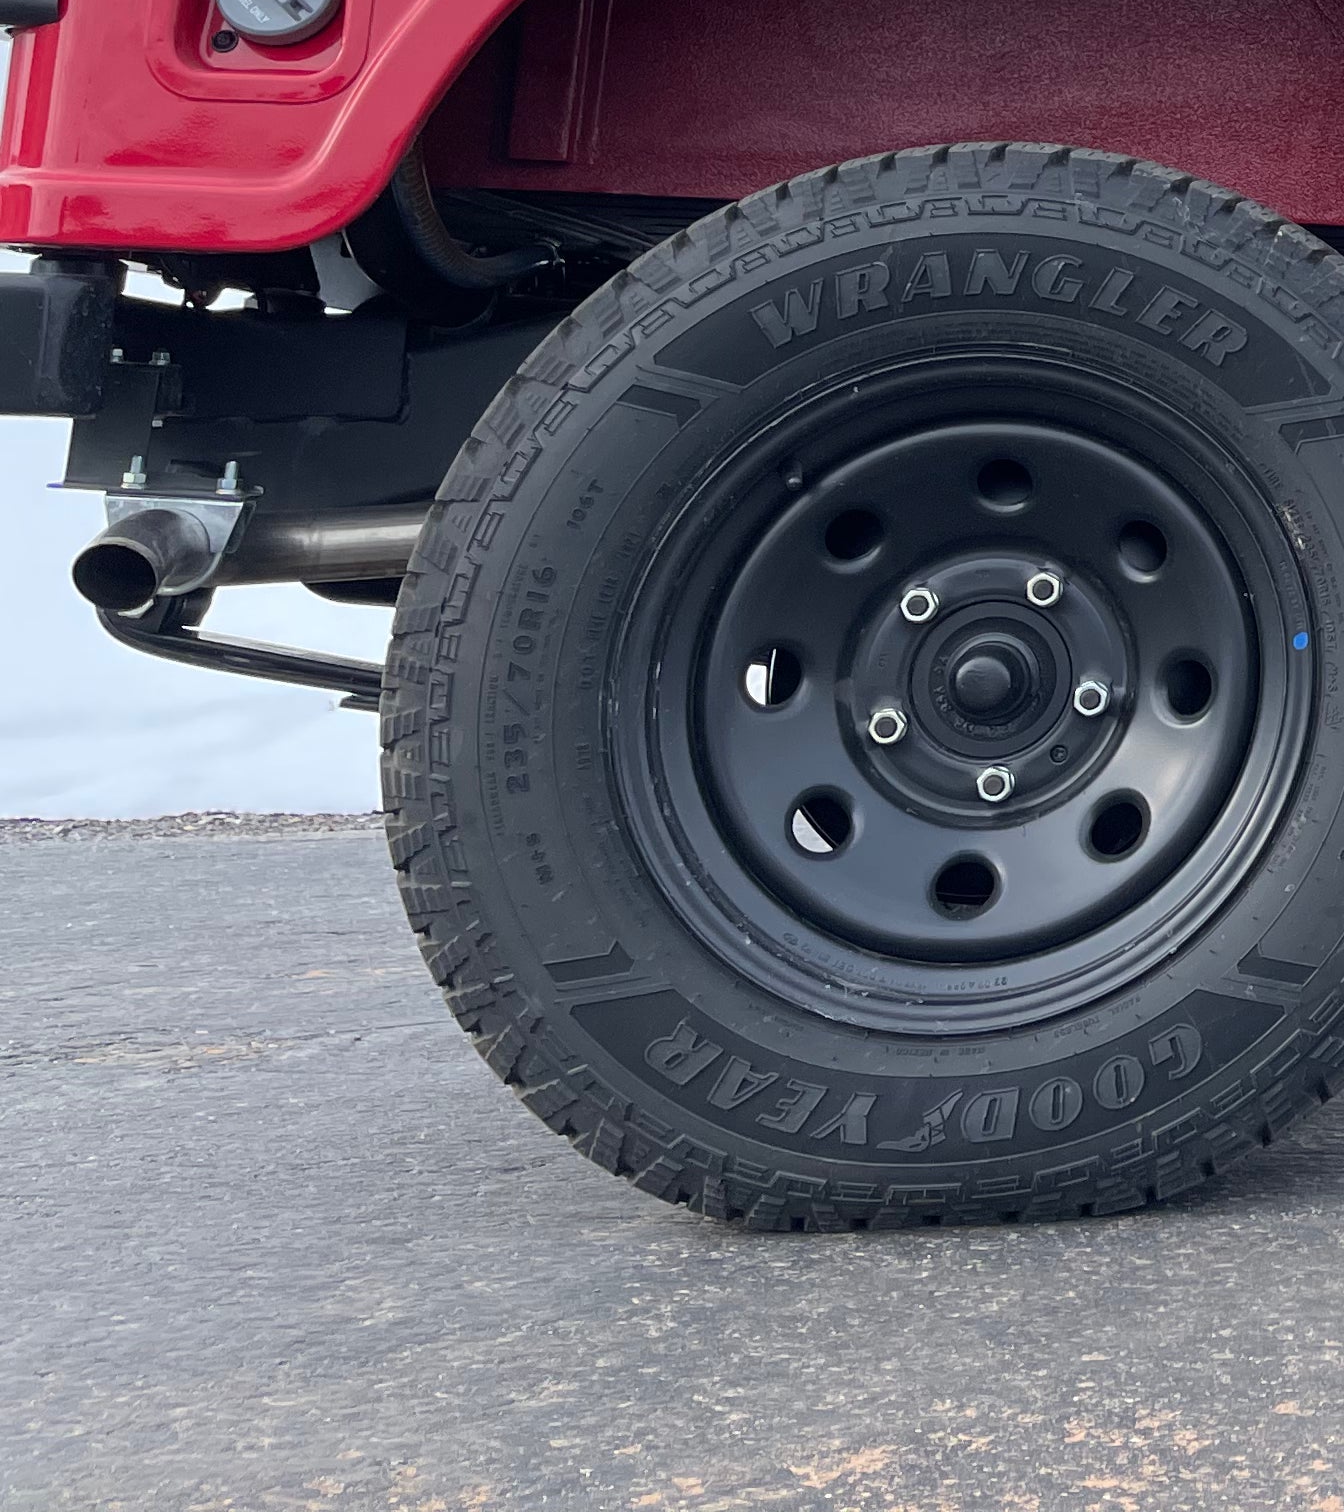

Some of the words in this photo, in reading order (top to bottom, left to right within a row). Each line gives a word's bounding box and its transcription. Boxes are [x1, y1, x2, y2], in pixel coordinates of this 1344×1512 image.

[249, 3, 270, 24] ONLY
[751, 246, 1249, 365] WRANGLER
[566, 478, 604, 531] 106T
[503, 564, 558, 795] 235/70R16
